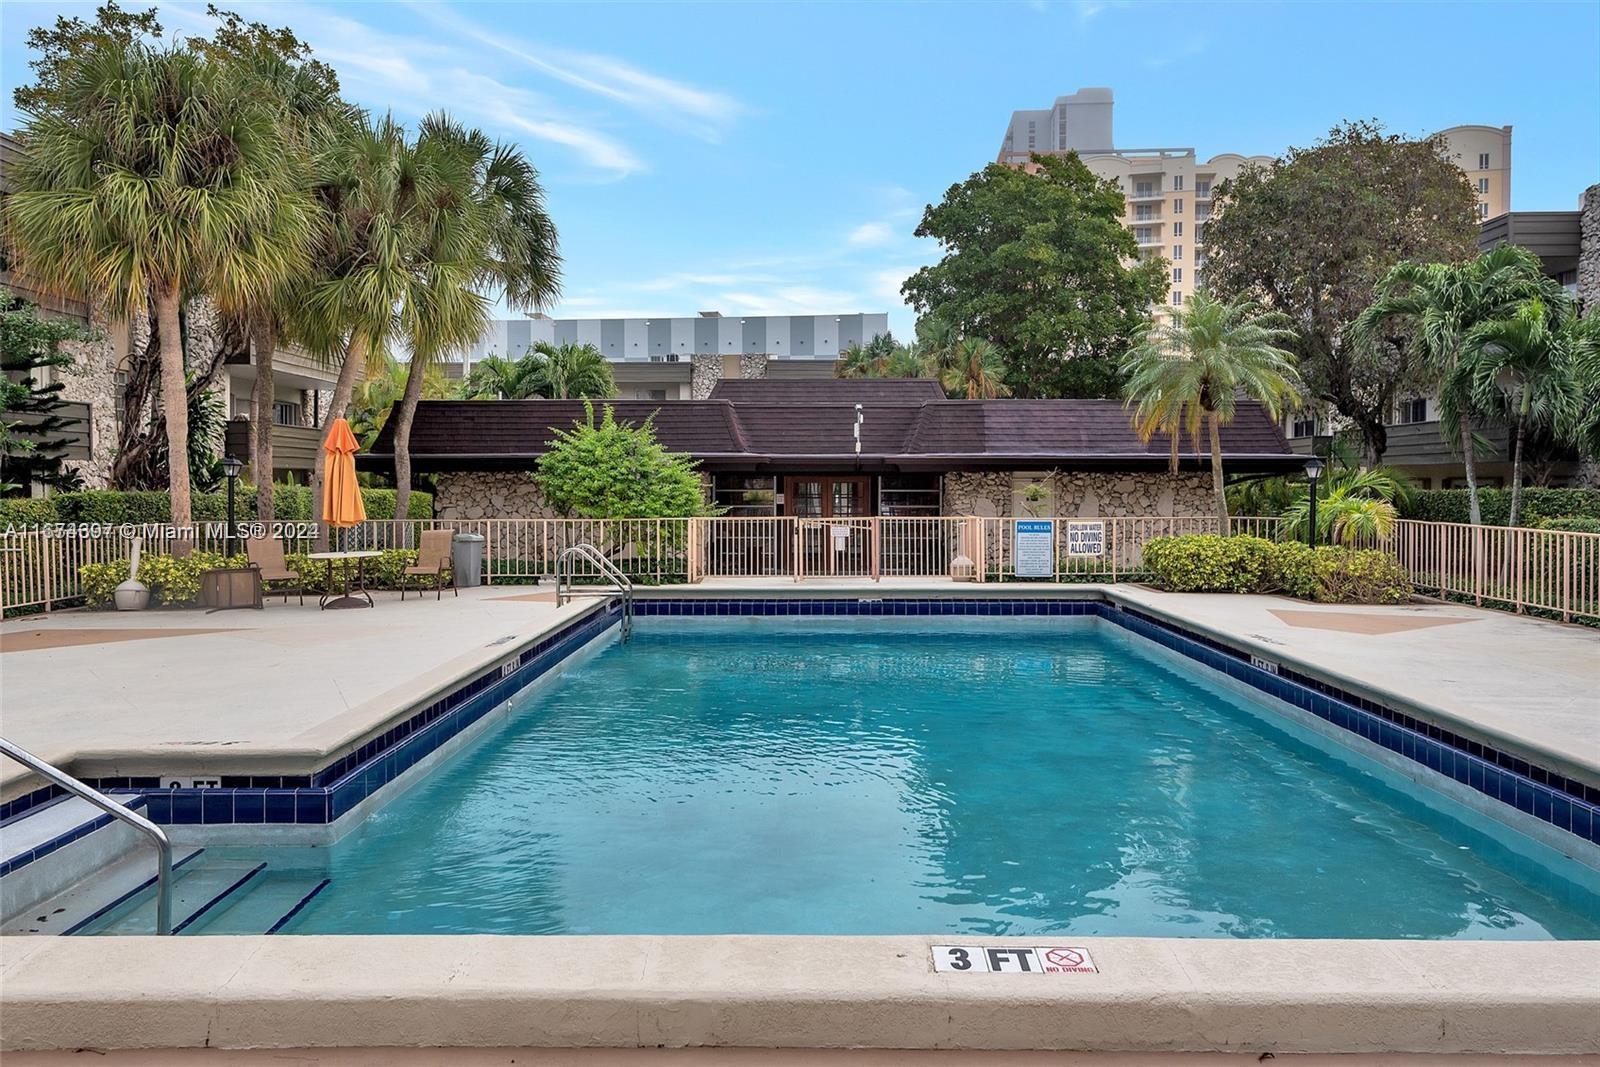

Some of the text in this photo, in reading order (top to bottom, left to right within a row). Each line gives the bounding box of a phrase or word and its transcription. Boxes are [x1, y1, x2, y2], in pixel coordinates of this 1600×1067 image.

[1070, 532, 1103, 543] NO DIVING
[1071, 543, 1102, 553] ALLOWED
[948, 948, 1033, 972] 3 FT
